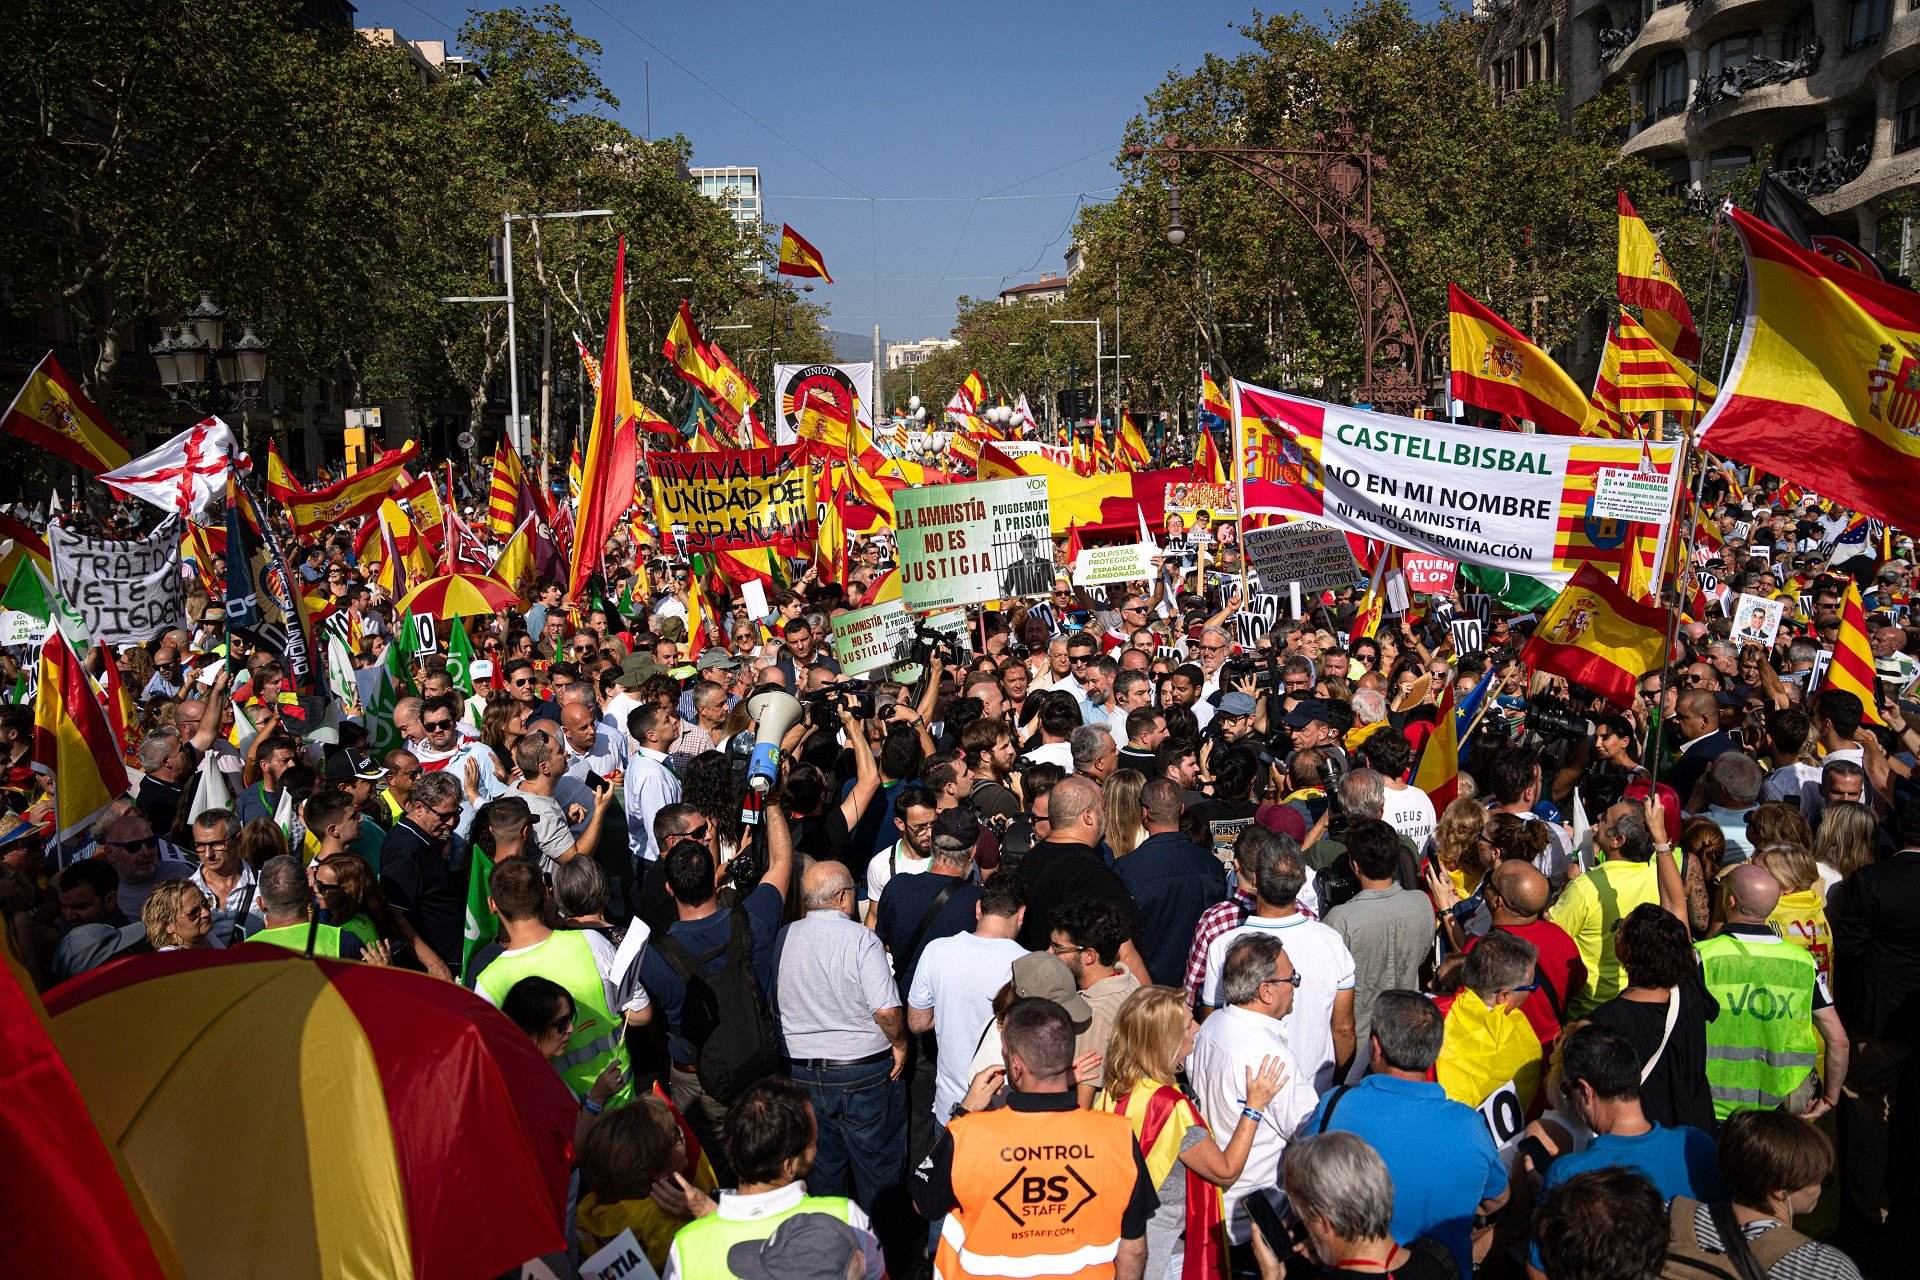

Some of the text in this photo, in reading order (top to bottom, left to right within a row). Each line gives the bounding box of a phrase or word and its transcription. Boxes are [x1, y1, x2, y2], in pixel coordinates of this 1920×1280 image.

[803, 366, 837, 377] UNIÓN
[1337, 424, 1552, 476] CASTELLBISBAL
[1026, 478, 1047, 490] VOX
[1605, 469, 1616, 478] NO
[1632, 473, 1669, 485] AMNISTÍA
[1627, 481, 1669, 493] DEMOCRACIA
[768, 478, 806, 506] DE
[1326, 464, 1552, 521] NO EN MI NOMBRE
[895, 497, 987, 531] LA AMNISTÍA
[992, 499, 1049, 516] PUIGDEMONT
[994, 512, 1050, 533] A PRISIÓN
[1381, 503, 1482, 534] NI AMNISTÍA
[924, 529, 966, 554] NO ES
[1337, 502, 1533, 561] NI AUTODETERMINACIÓN
[69, 546, 178, 580] TRAIDO
[1088, 555, 1139, 566] PROTEGIDOS
[1091, 548, 1135, 559] GOLPISTAS
[902, 552, 992, 584] JUSTICIA
[1085, 569, 1146, 580] ABANDONADOS
[1092, 564, 1137, 574] ESPAÑOLES
[1411, 572, 1448, 583] EL OP
[62, 578, 147, 609] VETE
[835, 614, 883, 638] LA AMNISTÍA
[851, 632, 874, 648] NO ES
[1453, 621, 1480, 657] NO
[842, 642, 889, 665] JUSTICIA
[1395, 810, 1422, 824] DEUS
[1727, 984, 1796, 1022] VOX
[1000, 1144, 1095, 1162] CONTROL
[1022, 1175, 1069, 1204] BS
[1022, 1203, 1068, 1217] STAFF
[1011, 1227, 1076, 1240] BSSTAFF.COM
